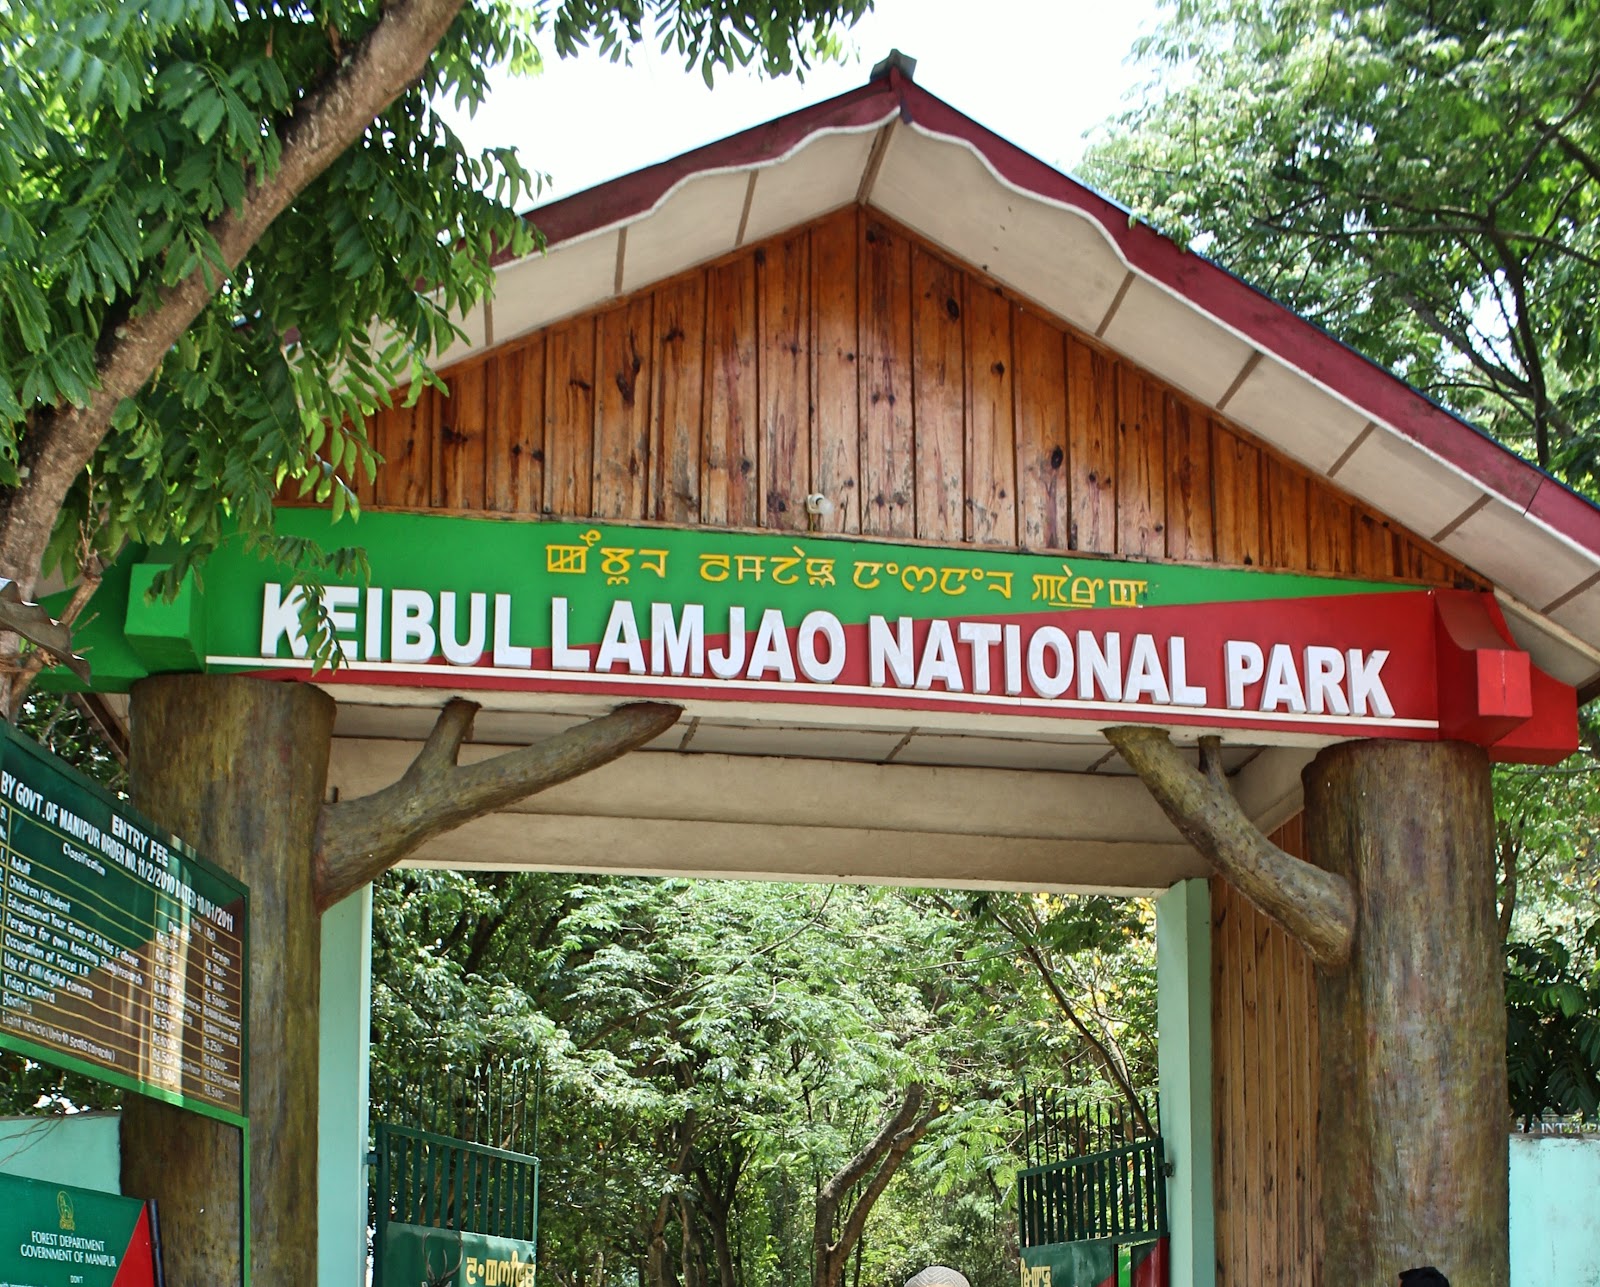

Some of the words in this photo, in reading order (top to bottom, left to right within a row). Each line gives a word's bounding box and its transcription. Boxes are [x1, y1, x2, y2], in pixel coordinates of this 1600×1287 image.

[261, 582, 531, 668] KEIBUL
[552, 597, 846, 683] LAMJAO
[870, 616, 1206, 707] NATIONAL
[1224, 641, 1395, 717] PARK
[1, 770, 16, 799] BY
[59, 807, 100, 849] MANIPUR
[101, 833, 125, 866] ORDER
[175, 879, 197, 909] DATED
[112, 814, 148, 853] ENTRY
[150, 840, 169, 867] FEE
[11, 855, 31, 875] Adult
[8, 893, 50, 923] Educational
[6, 912, 36, 938] Persons
[38, 927, 51, 942] for
[52, 935, 68, 950] own
[4, 951, 18, 971] Use
[18, 959, 28, 972] of
[3, 972, 25, 994] Video
[31, 1230, 58, 1246] FOREST
[59, 1234, 105, 1252] DEPARTMENT
[20, 1243, 73, 1262] GOVERNMENT
[73, 1250, 84, 1263] OF
[85, 1253, 117, 1268] MANIPUR
